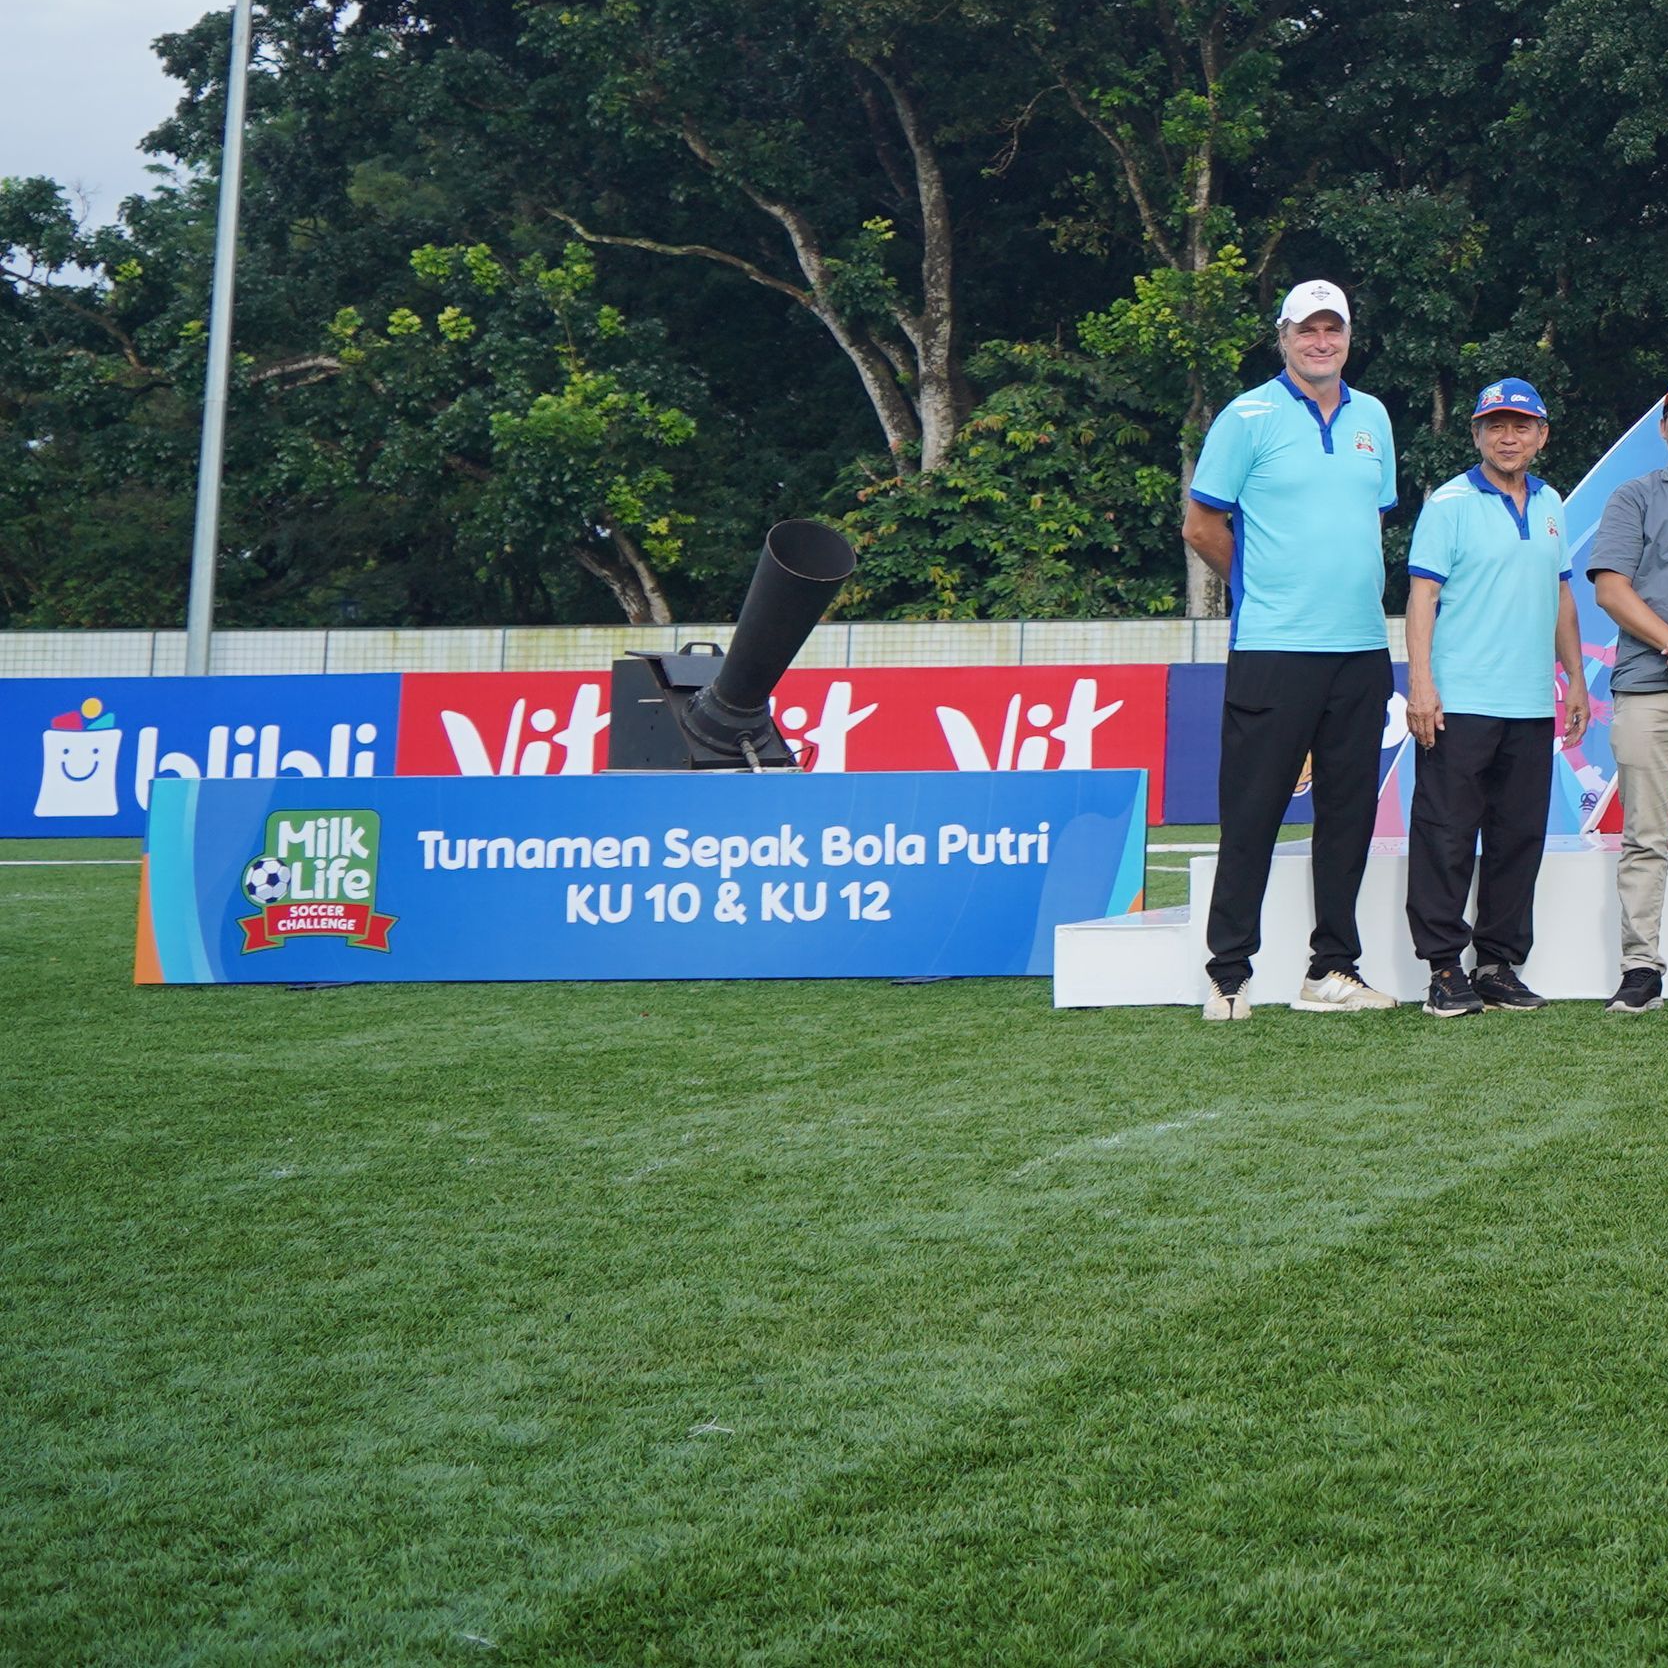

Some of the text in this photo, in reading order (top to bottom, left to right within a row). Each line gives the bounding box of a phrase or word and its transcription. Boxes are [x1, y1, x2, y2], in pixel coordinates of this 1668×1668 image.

[769, 680, 879, 773] it
[277, 816, 371, 861] Milk
[416, 821, 1050, 878] Turnamen Sepak Bola Putri
[288, 858, 372, 902] Life
[276, 917, 357, 933] CHALLENGE
[288, 904, 345, 919] SOCCER
[565, 880, 892, 926] KU 10 & KU 12
